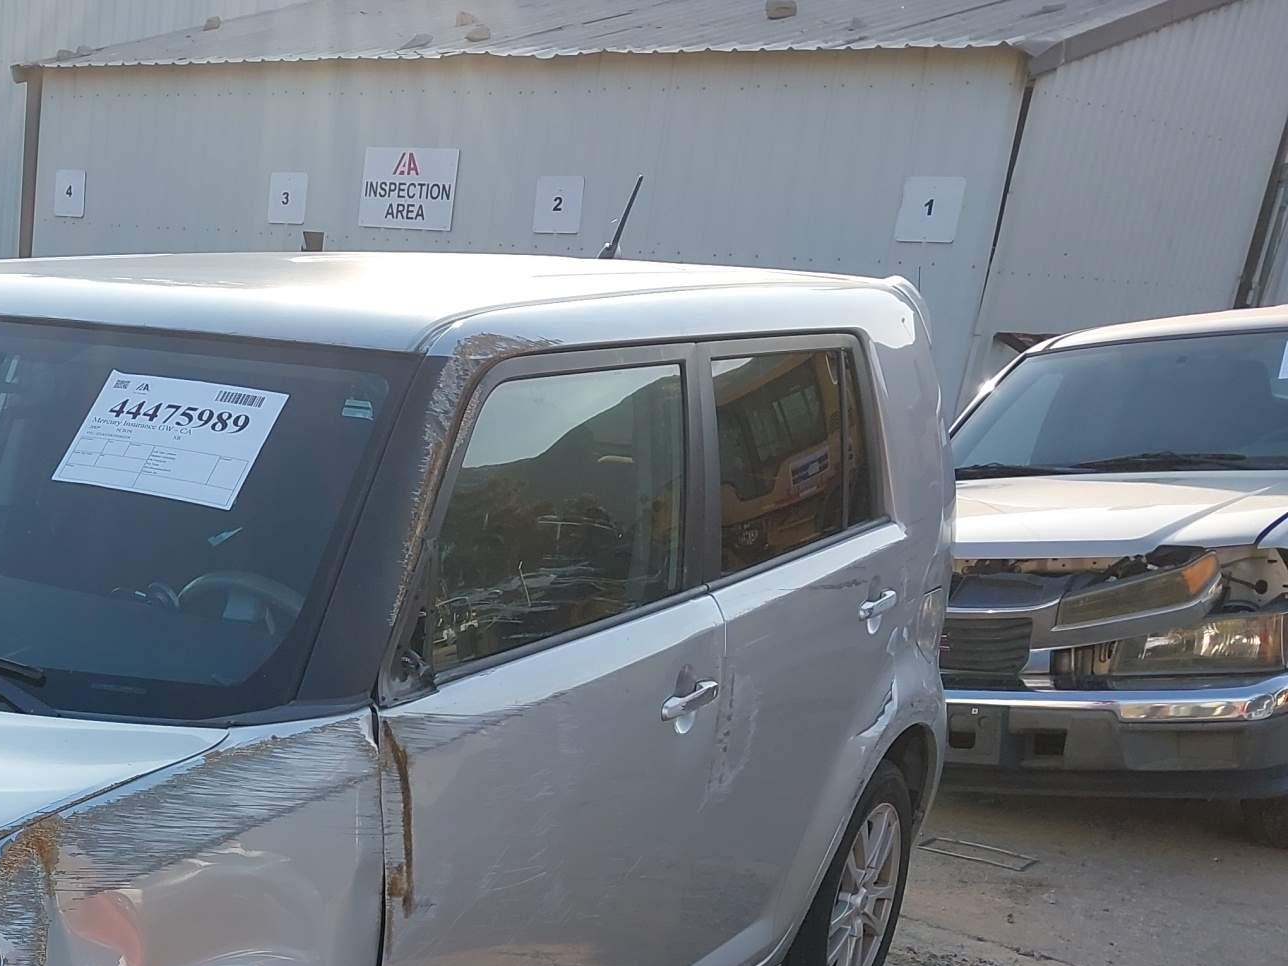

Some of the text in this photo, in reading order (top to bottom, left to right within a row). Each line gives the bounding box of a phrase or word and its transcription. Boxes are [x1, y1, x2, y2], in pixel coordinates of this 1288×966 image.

[65, 185, 73, 198] 4
[281, 191, 290, 206] 3
[364, 181, 452, 201] INSPECTION
[384, 202, 426, 221] AREA
[552, 196, 563, 212] 2
[923, 198, 935, 216] 1
[92, 416, 121, 427] Mercury
[123, 420, 156, 431] Insurance
[109, 398, 250, 434] 44475989
